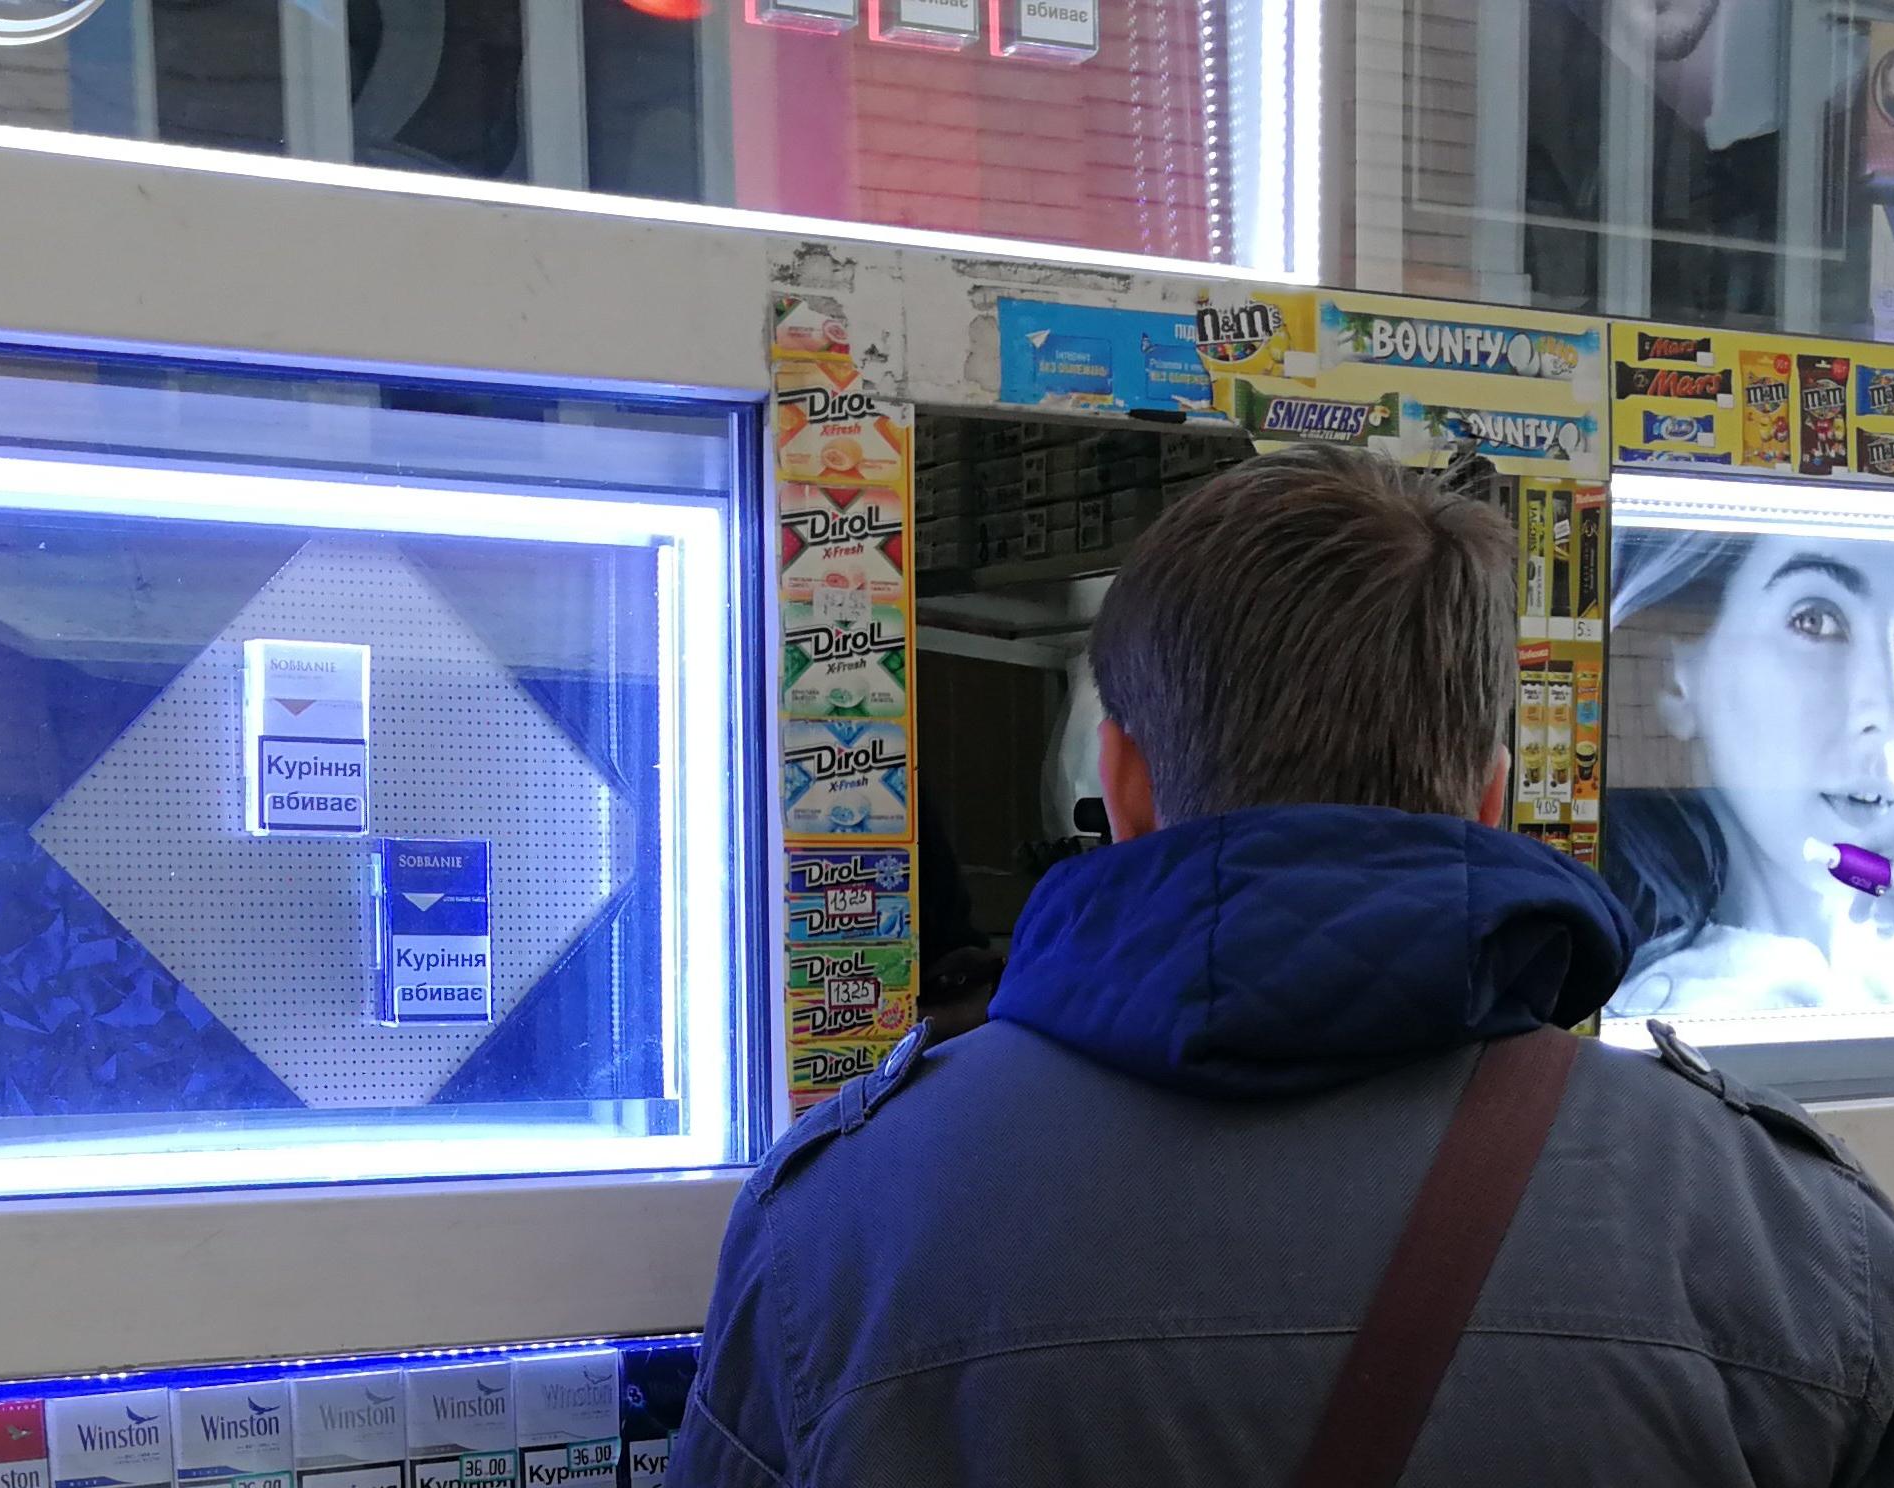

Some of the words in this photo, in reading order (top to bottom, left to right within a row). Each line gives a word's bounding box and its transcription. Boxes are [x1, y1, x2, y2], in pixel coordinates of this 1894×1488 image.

[1027, 3, 1088, 24] вбиває
[1373, 319, 1505, 368] BOUNTY
[1648, 368, 1721, 396] Mars
[1266, 399, 1369, 435] SNICKERS
[270, 657, 337, 673] SOBRANIE
[267, 754, 362, 779] Куріння
[272, 792, 358, 812] вбиває
[398, 853, 464, 870] SOBRANIE
[396, 947, 487, 971] Куріння
[401, 983, 484, 1002] вбиває
[202, 1411, 281, 1442] Winston
[318, 1401, 396, 1430] Winston
[76, 1421, 161, 1454] Winston
